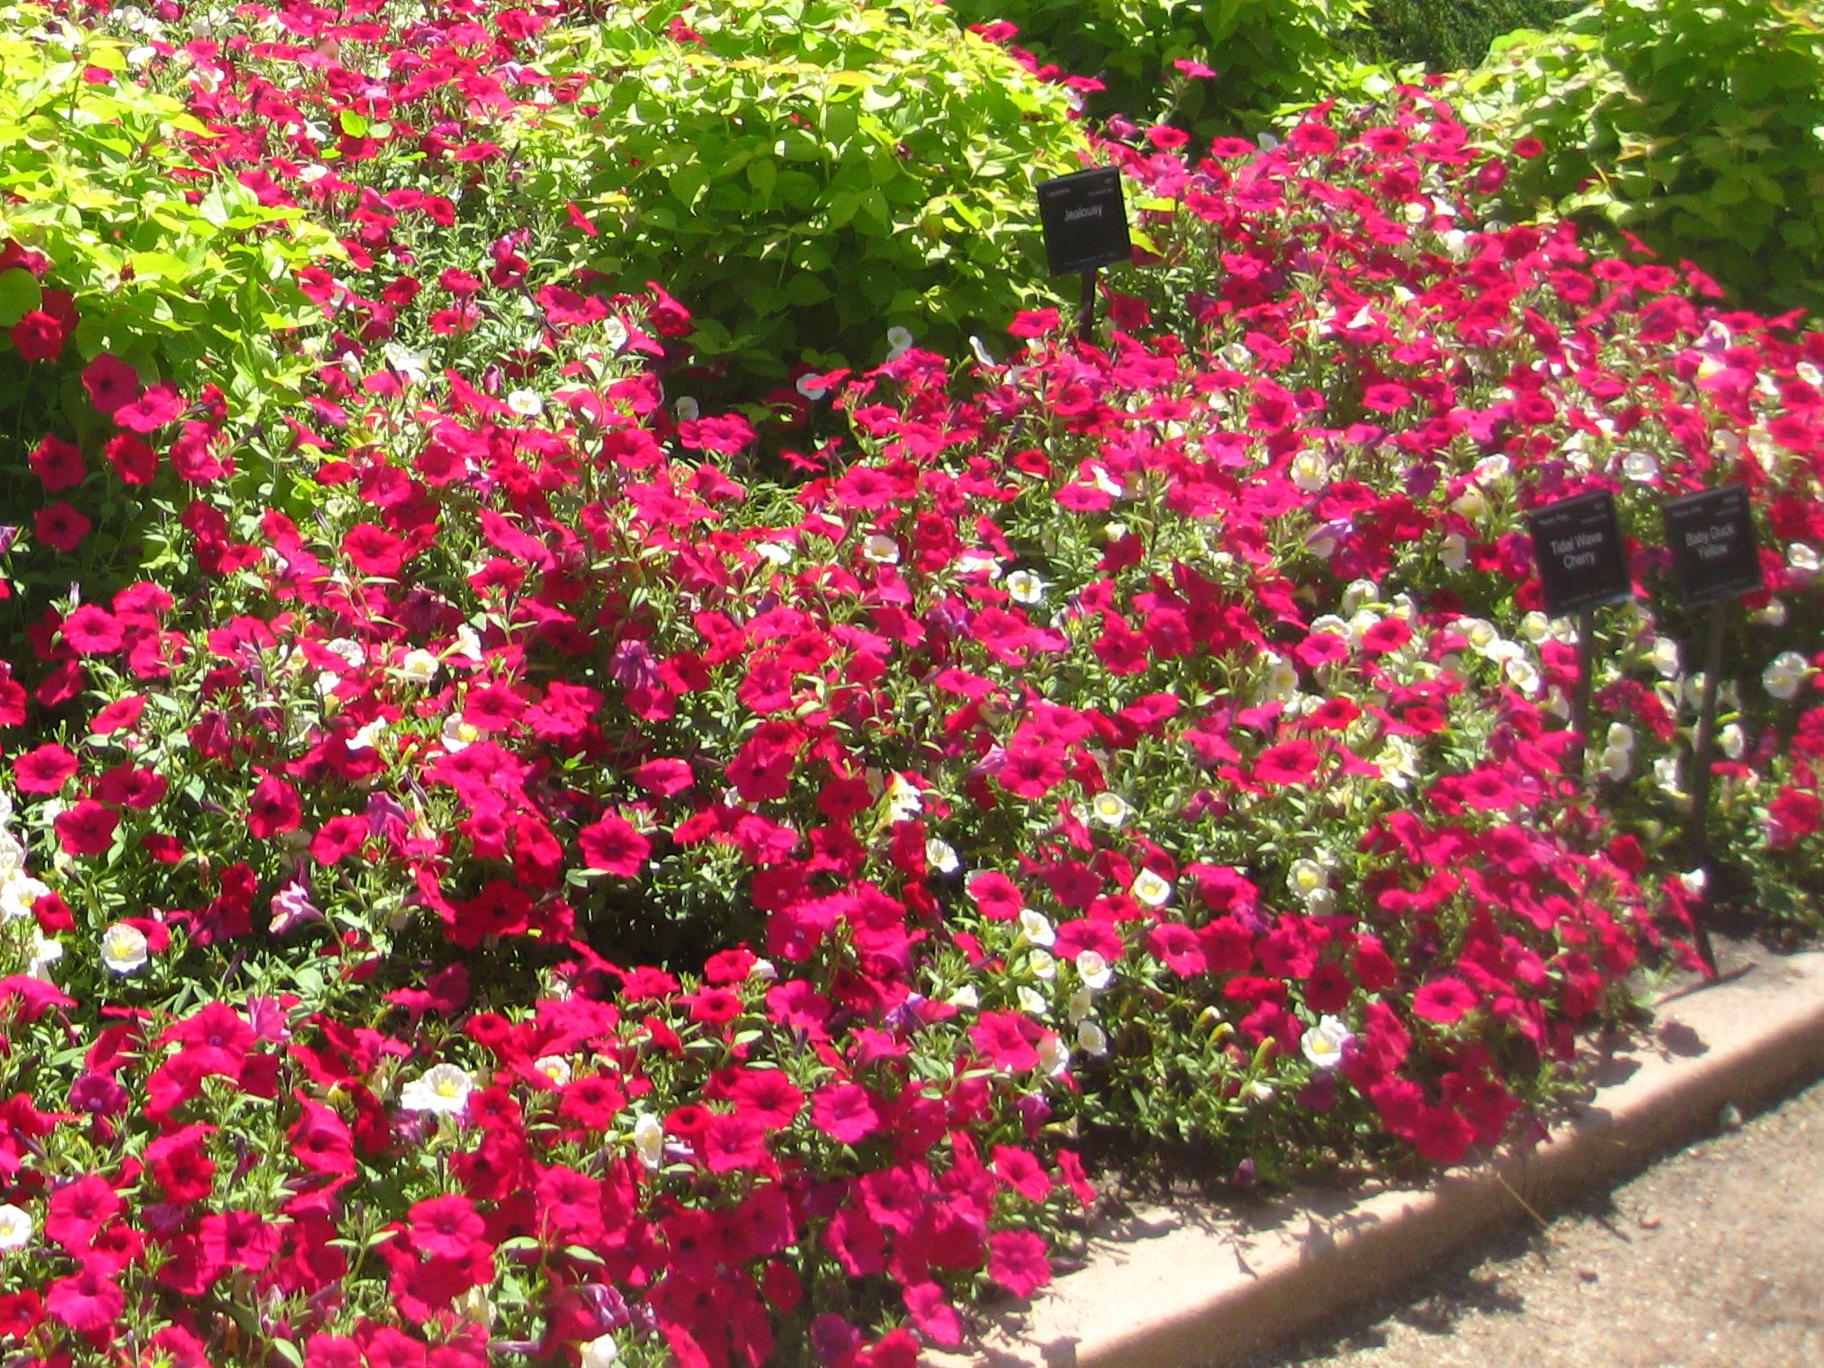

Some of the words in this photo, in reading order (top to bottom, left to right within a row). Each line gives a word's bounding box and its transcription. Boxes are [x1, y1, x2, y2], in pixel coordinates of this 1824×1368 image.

[1064, 204, 1103, 222] Jealousy
[1550, 537, 1574, 555] Tidal
[1575, 532, 1603, 548] Wave
[1563, 552, 1594, 570] Cherry
